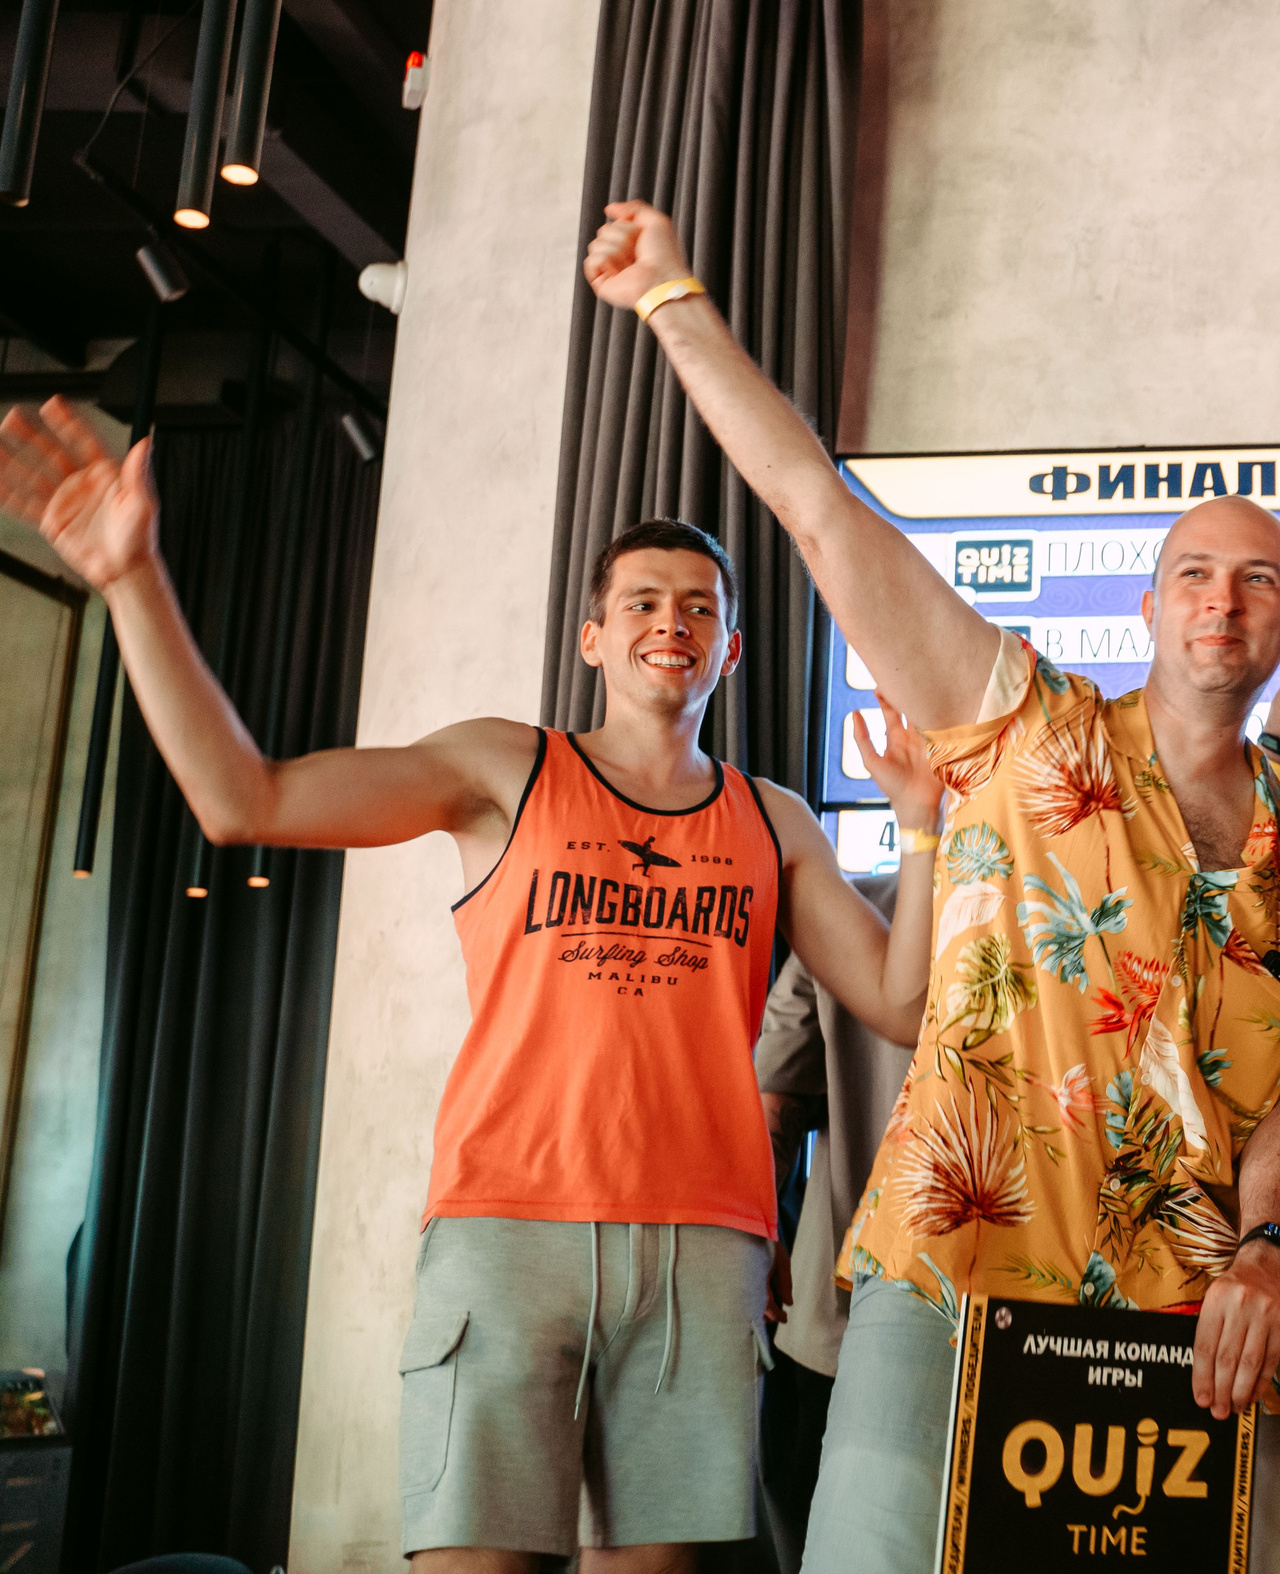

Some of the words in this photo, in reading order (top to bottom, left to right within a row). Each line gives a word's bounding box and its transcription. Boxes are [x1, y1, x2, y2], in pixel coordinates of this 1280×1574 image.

[957, 564, 1029, 584] TIME
[1047, 628, 1064, 659] В
[566, 841, 611, 853] EST.
[524, 868, 754, 948] LONGBOARDS
[557, 940, 647, 968] Surfing
[653, 946, 709, 973] Shop
[587, 971, 679, 986] MALIBU
[617, 986, 644, 997] CA
[1023, 1333, 1109, 1360] ЛУЧШАЯ
[1114, 1340, 1194, 1368] КОМАНД
[1087, 1365, 1143, 1388] ИГРЫ
[1066, 1523, 1148, 1556] TIME
